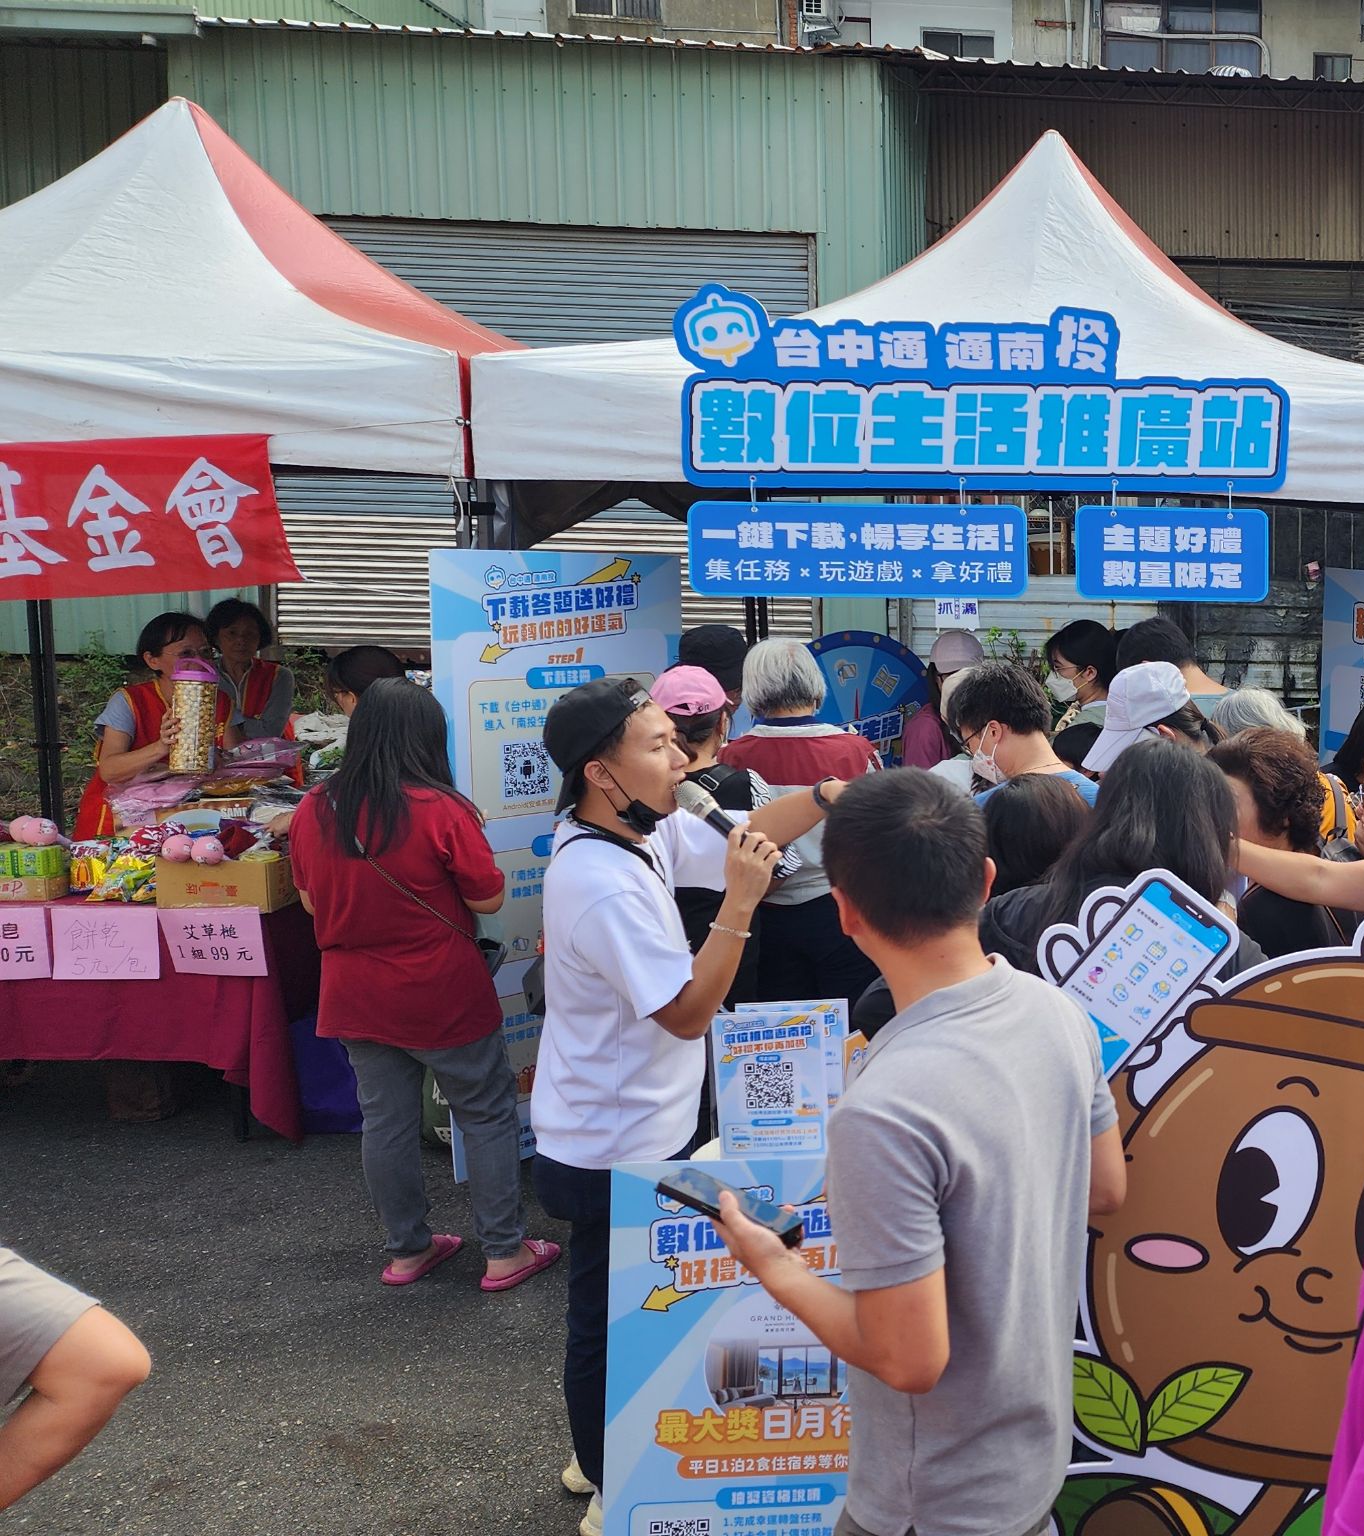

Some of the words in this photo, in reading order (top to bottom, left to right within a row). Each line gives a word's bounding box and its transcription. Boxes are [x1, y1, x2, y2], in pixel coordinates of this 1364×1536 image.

[773, 328, 928, 369] 台中通
[945, 314, 1109, 373] 通南投
[700, 388, 1273, 468] 數位生活推廣站
[1103, 524, 1242, 554] 主題好禮
[705, 559, 790, 582] 集任務
[819, 560, 904, 583] 玩遊戲
[931, 561, 1013, 583] 拿好禮
[1103, 560, 1242, 589] 數量限定
[487, 583, 635, 621] 下載答題送好禮
[502, 612, 623, 644] 玩轉你的好運氣
[183, 924, 239, 941] 艾草槌
[15, 946, 34, 962] 元
[210, 946, 229, 961] 99
[237, 947, 254, 962] 元
[750, 1315, 783, 1323] GRAND
[658, 1406, 851, 1443] 最大獎日月行
[689, 1454, 849, 1474] 平日1泊2食住宿券等你
